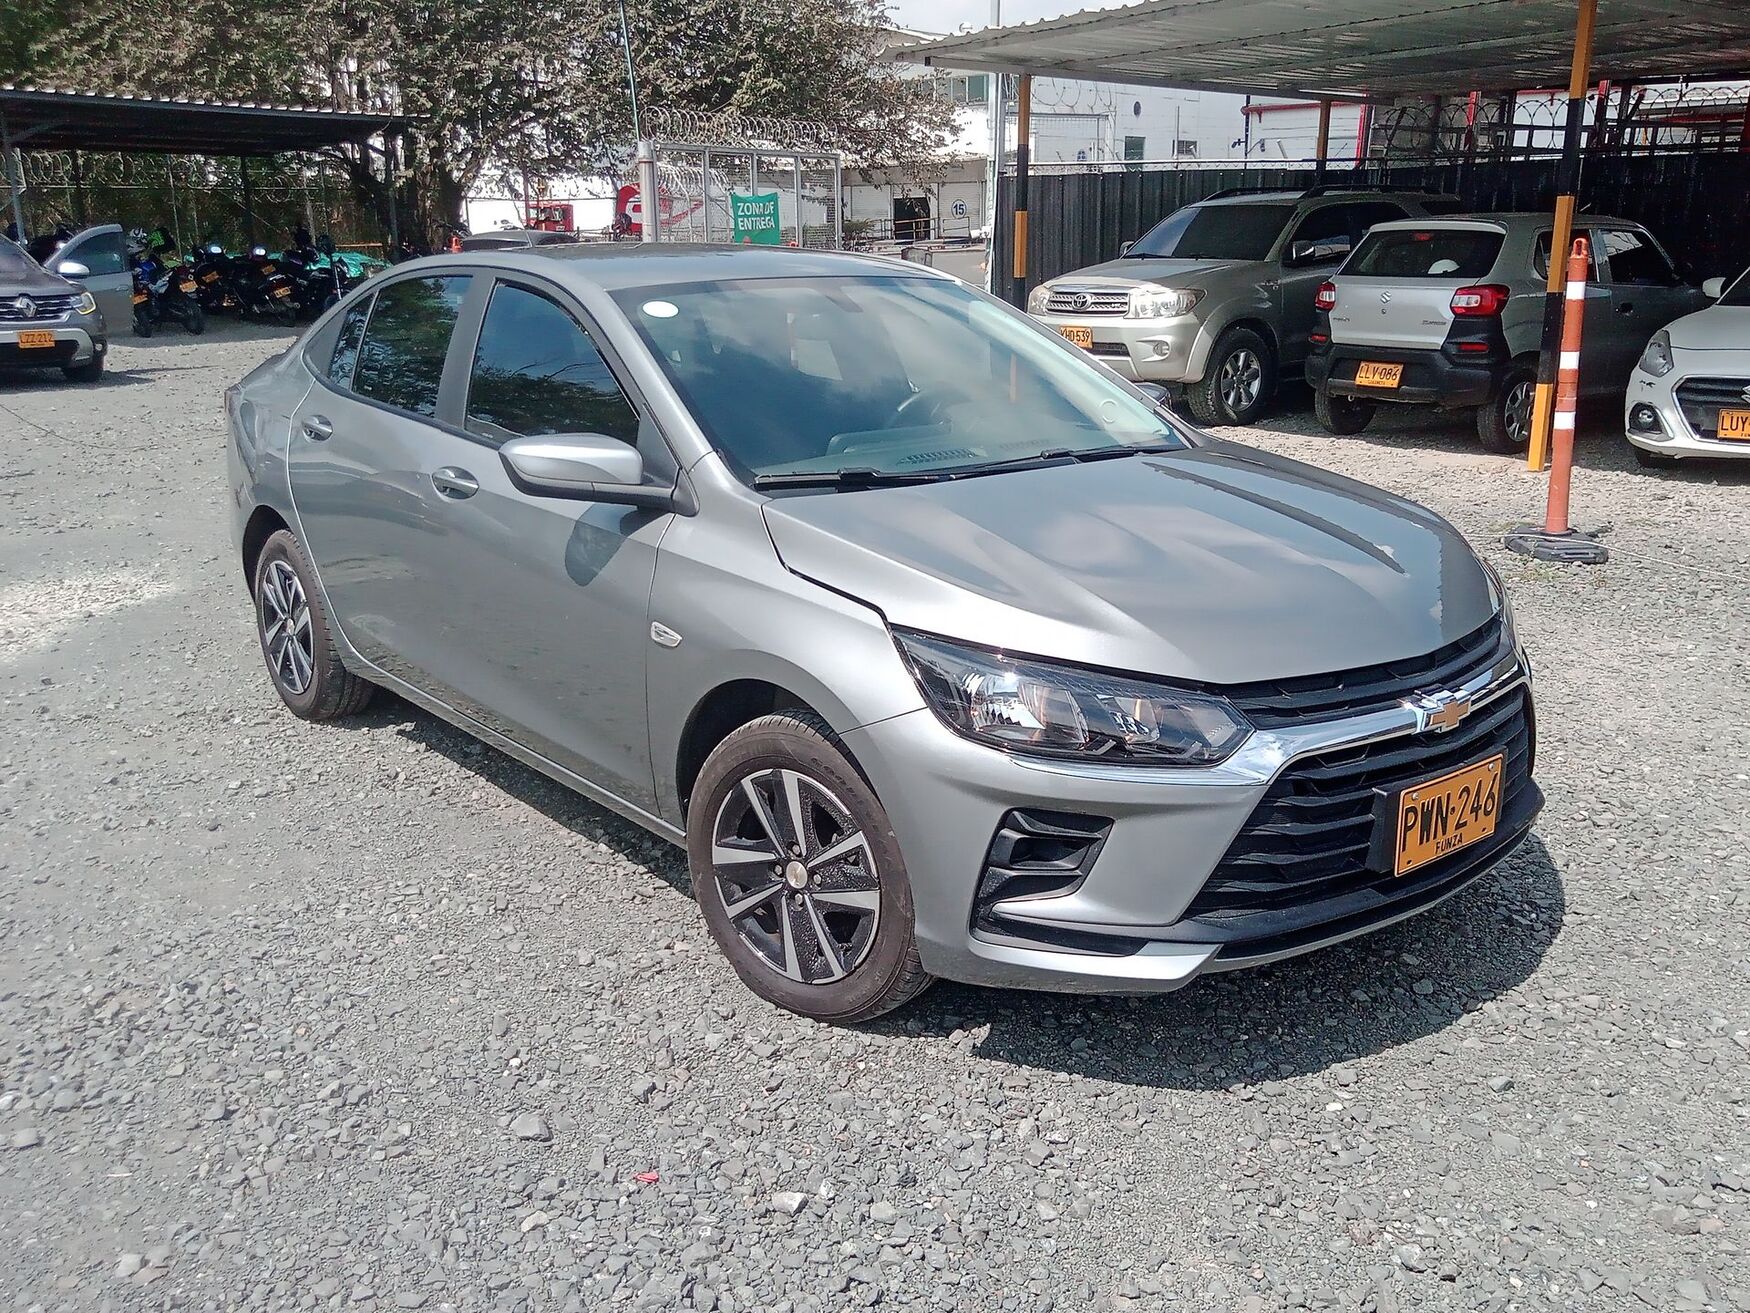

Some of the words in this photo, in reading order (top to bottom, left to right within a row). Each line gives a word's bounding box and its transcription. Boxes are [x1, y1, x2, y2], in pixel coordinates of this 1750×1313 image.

[737, 202, 764, 215] ZONA
[953, 203, 965, 215] 15
[737, 216, 775, 230] ENTREGA
[1435, 832, 1463, 855] FUNZA
